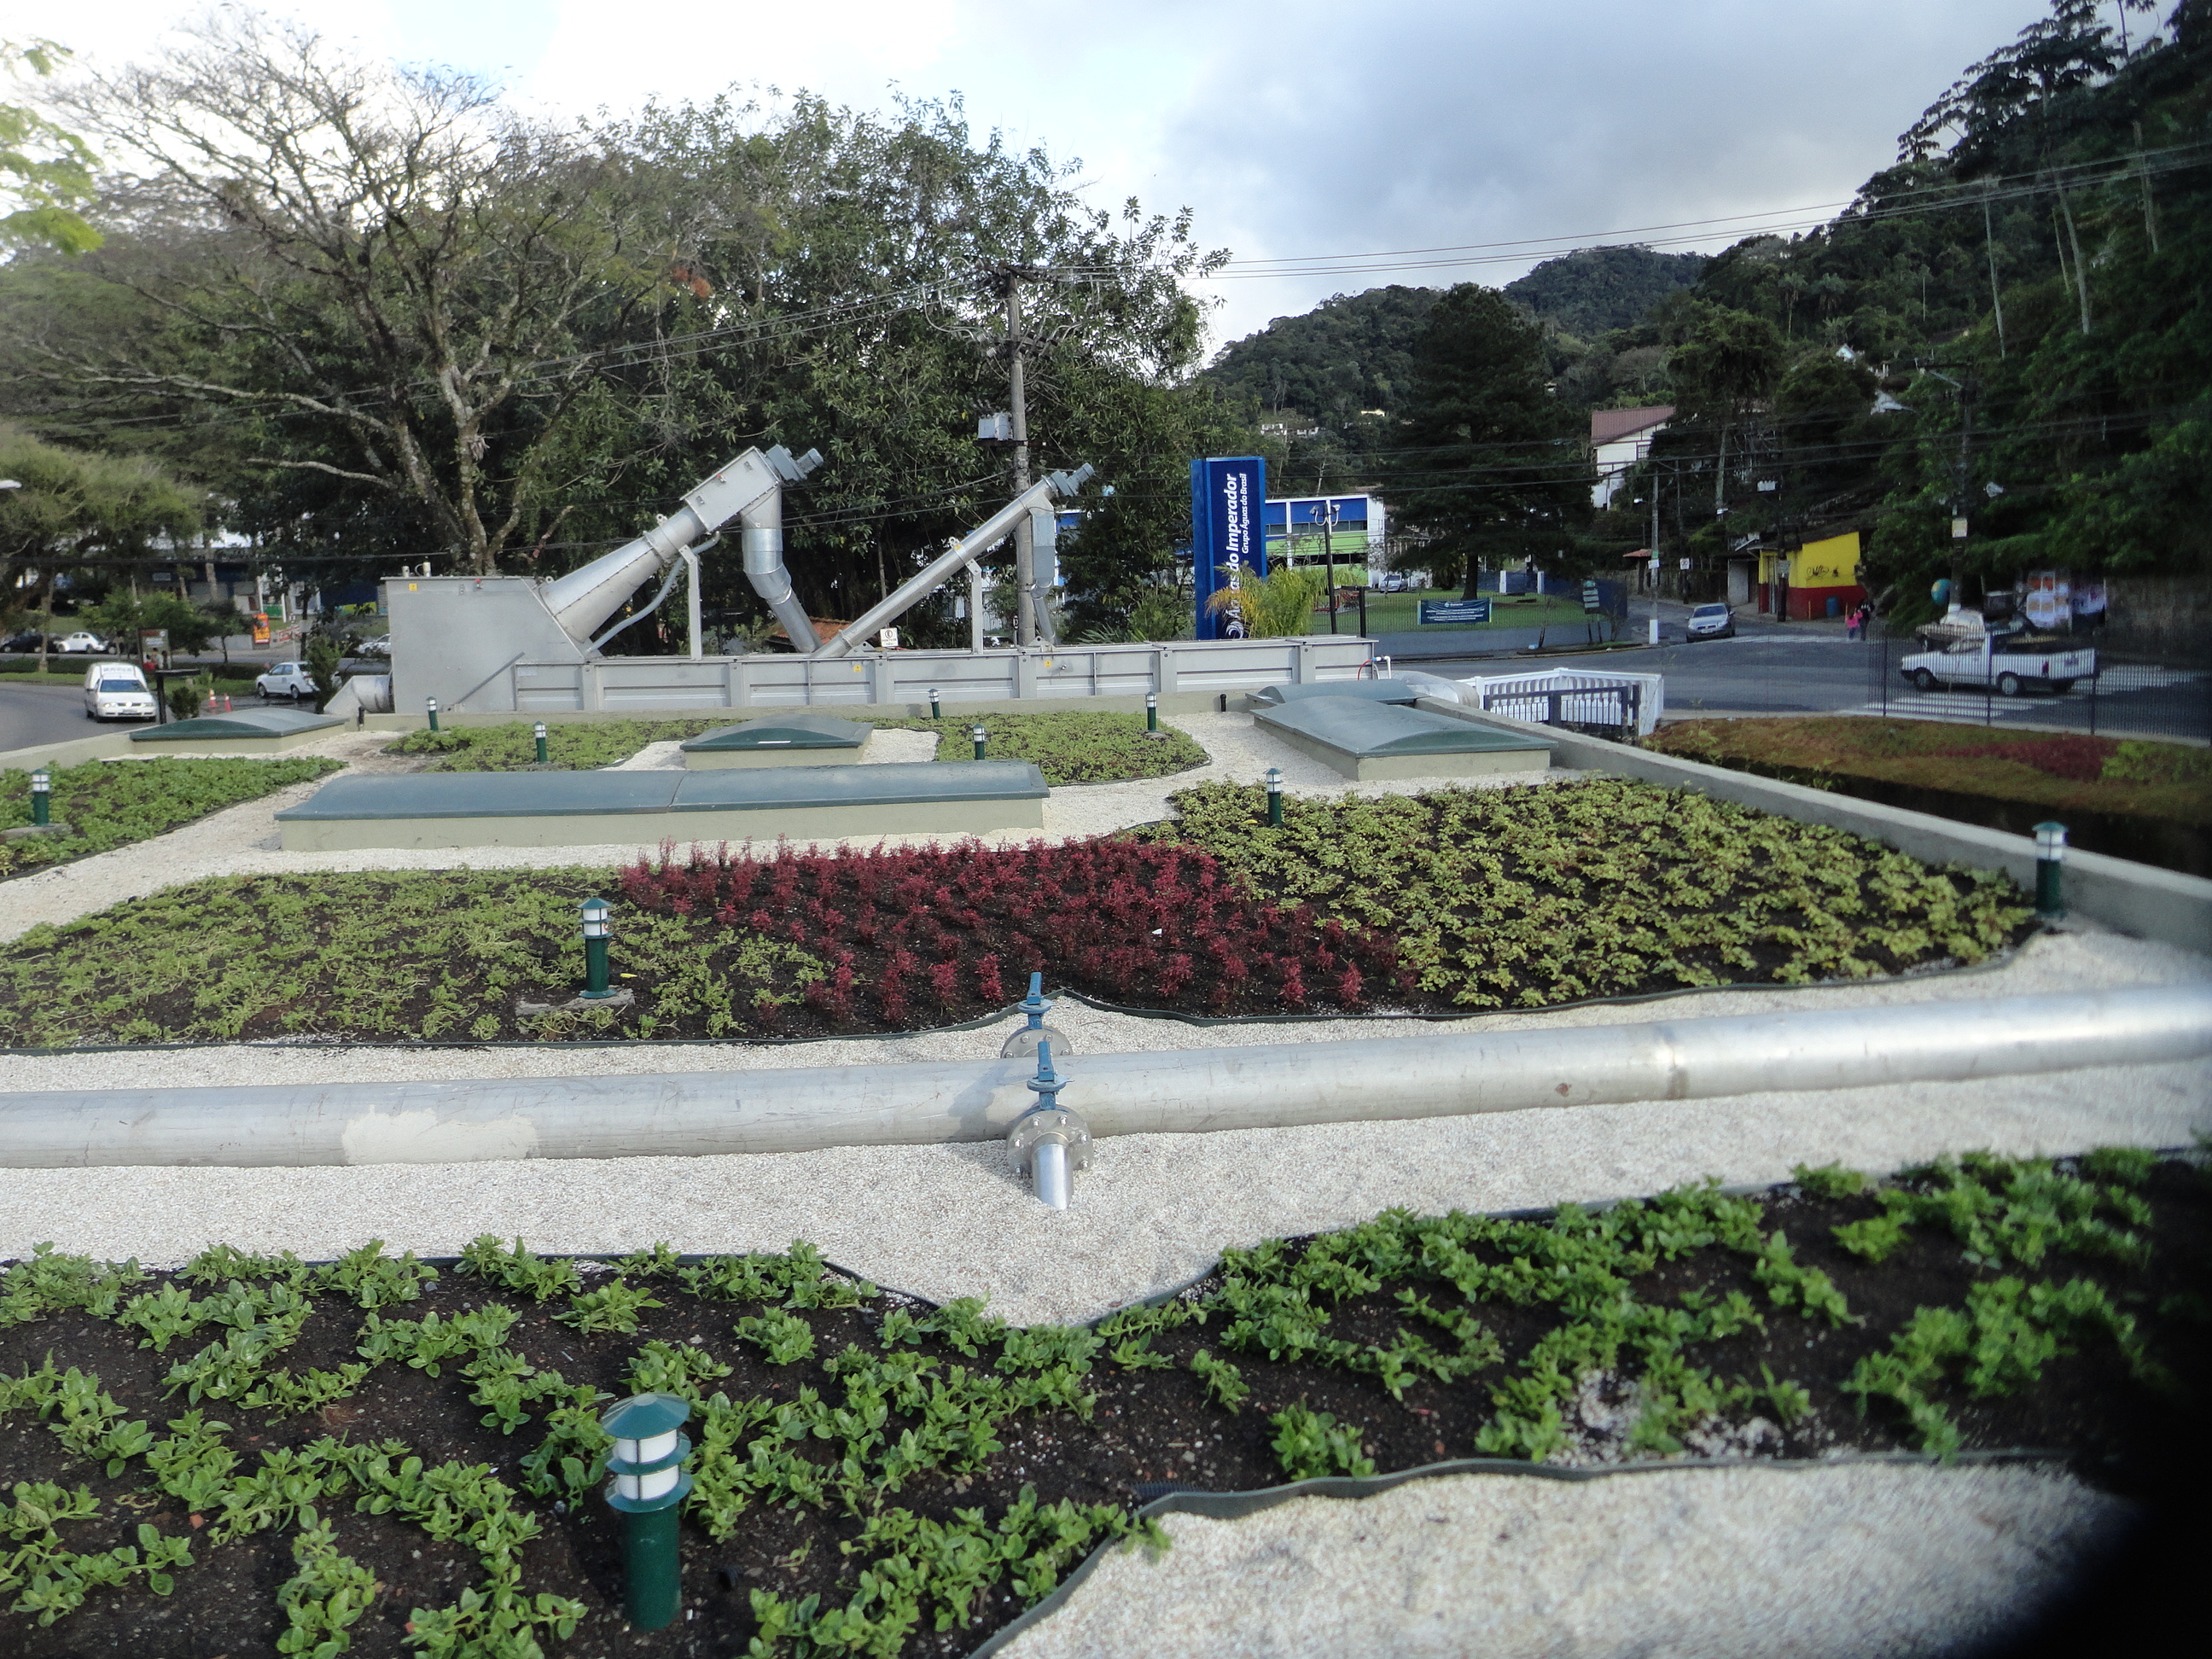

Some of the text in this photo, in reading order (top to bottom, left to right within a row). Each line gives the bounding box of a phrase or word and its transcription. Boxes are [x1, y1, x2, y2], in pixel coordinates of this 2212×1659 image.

[1224, 473, 1243, 620] Ágas do Imperador
[1239, 473, 1250, 554] Grupo Águas do Brasil
